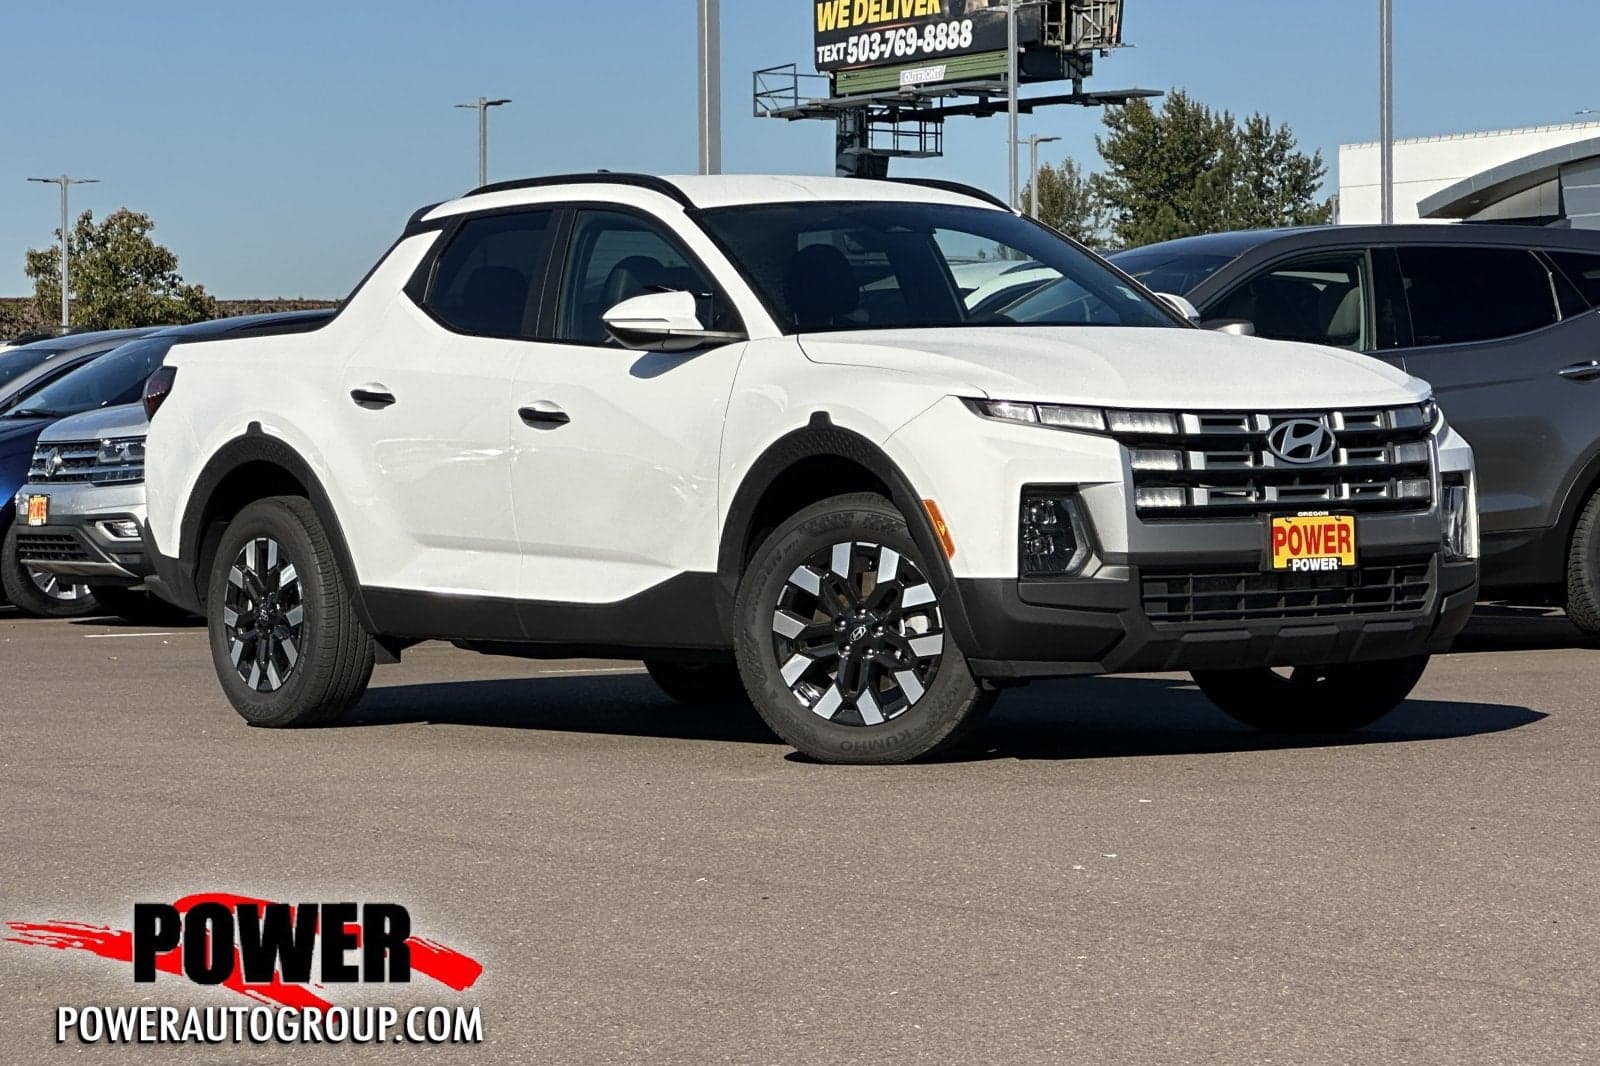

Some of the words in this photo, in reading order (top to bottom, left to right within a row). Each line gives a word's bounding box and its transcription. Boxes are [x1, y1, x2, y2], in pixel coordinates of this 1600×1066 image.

[817, 0, 850, 32] WE
[817, 42, 846, 63] TEXT
[847, 19, 973, 63] 503-769-8888
[1273, 524, 1351, 556] POWER
[1292, 558, 1338, 572] POWER
[840, 729, 911, 752] KUMHO
